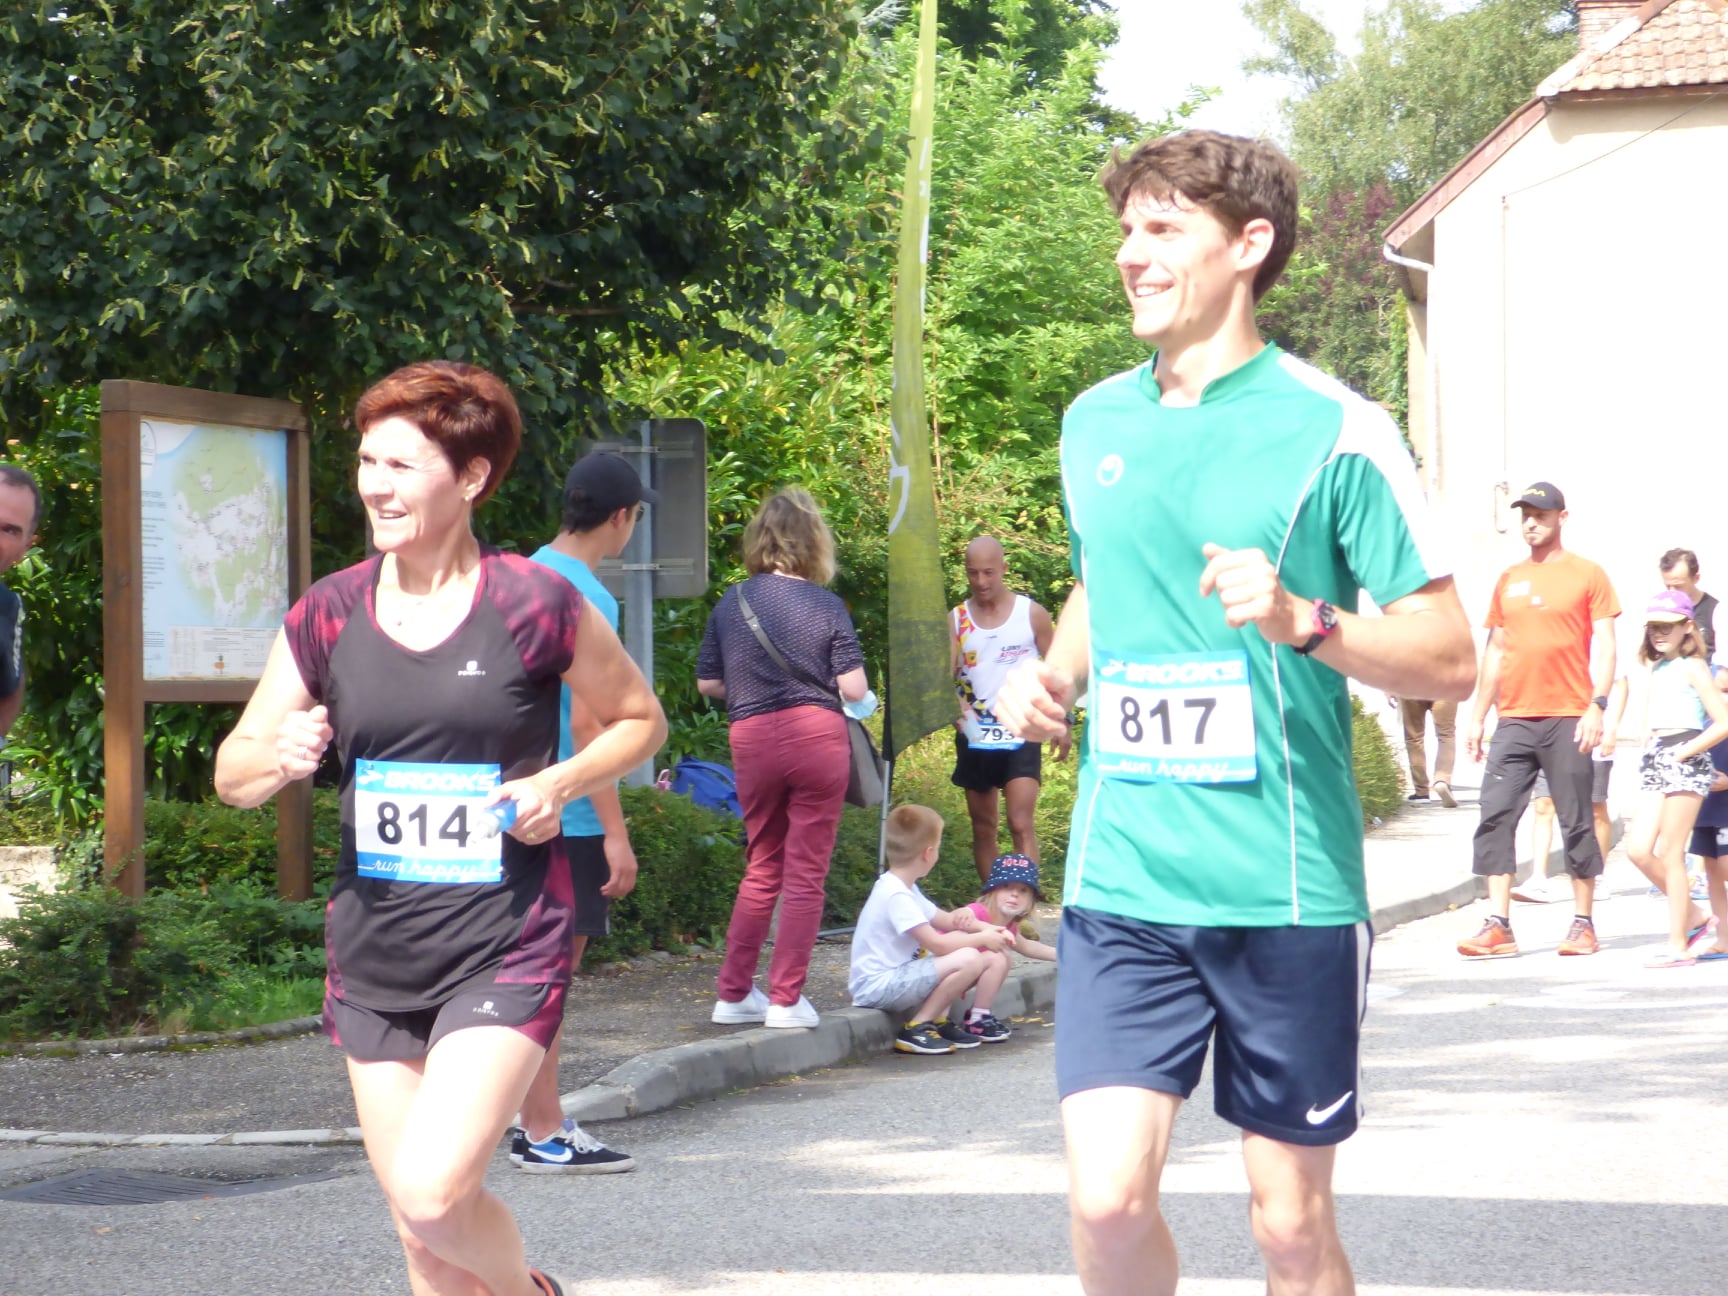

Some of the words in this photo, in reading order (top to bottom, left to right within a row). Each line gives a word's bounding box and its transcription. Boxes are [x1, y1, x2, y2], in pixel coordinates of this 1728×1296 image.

[1126, 661, 1244, 683] BROOKS
[1120, 696, 1216, 744] 817
[981, 727, 1015, 741] 793
[384, 771, 495, 791] BROOKS
[1156, 759, 1229, 782] happy
[377, 801, 471, 848] 814
[373, 860, 405, 873] run
[408, 859, 477, 881] happy
